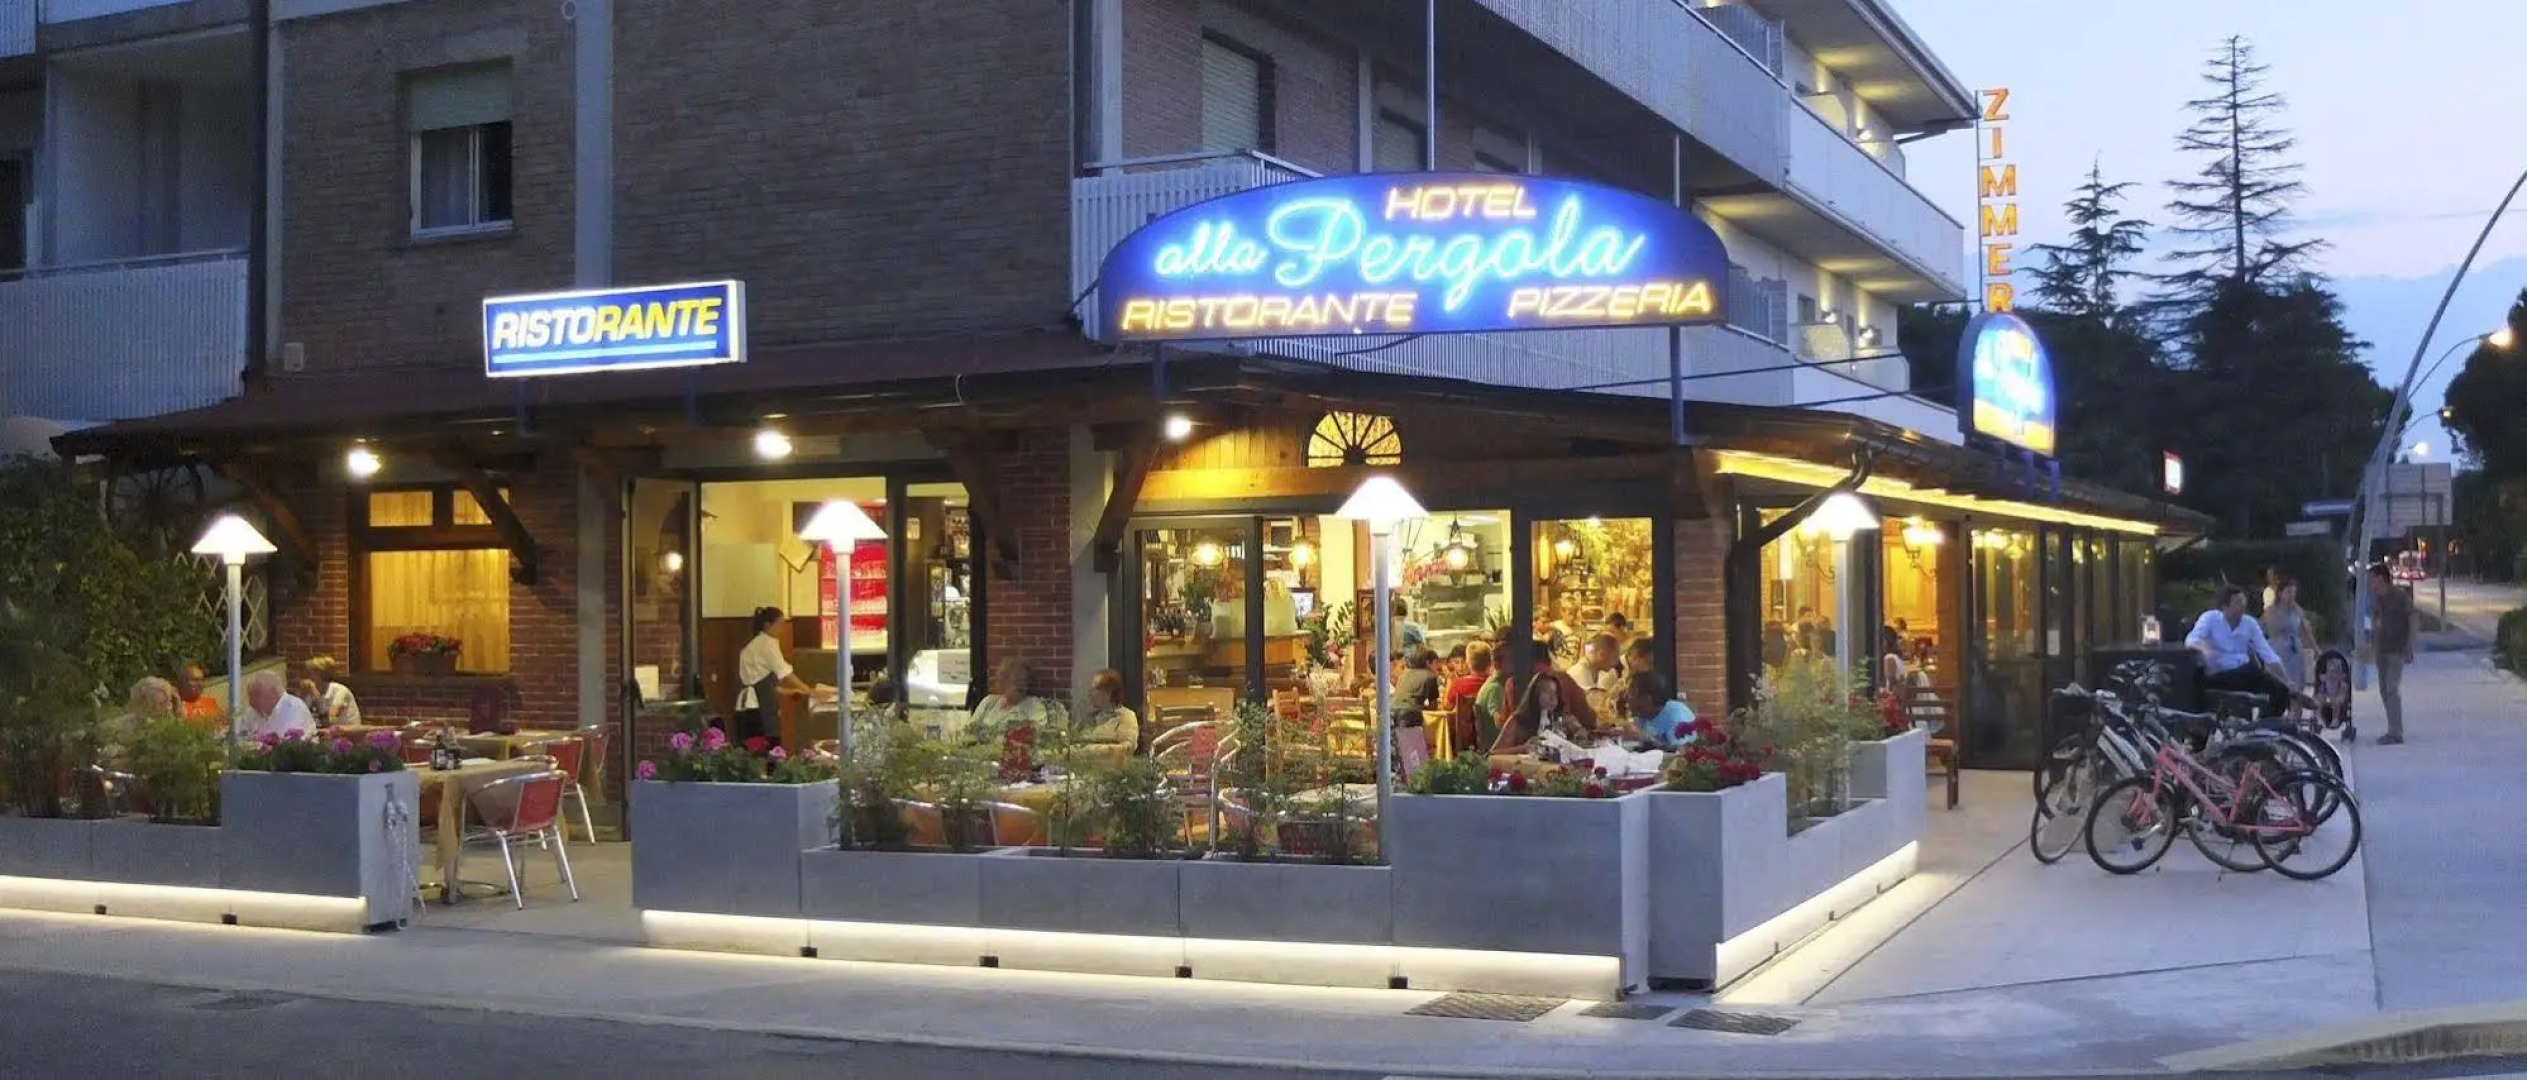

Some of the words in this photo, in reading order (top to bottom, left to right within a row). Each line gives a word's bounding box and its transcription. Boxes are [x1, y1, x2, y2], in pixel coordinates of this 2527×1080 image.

[1384, 185, 1538, 221] HOTEL
[1981, 86, 2019, 314] ZIMMER
[1154, 219, 1270, 277] alla
[1265, 194, 1647, 313] Pergola
[492, 297, 722, 350] RISTORANTE
[1121, 290, 1419, 332] RISTORANTE
[1506, 279, 1714, 320] PIZZERIA
